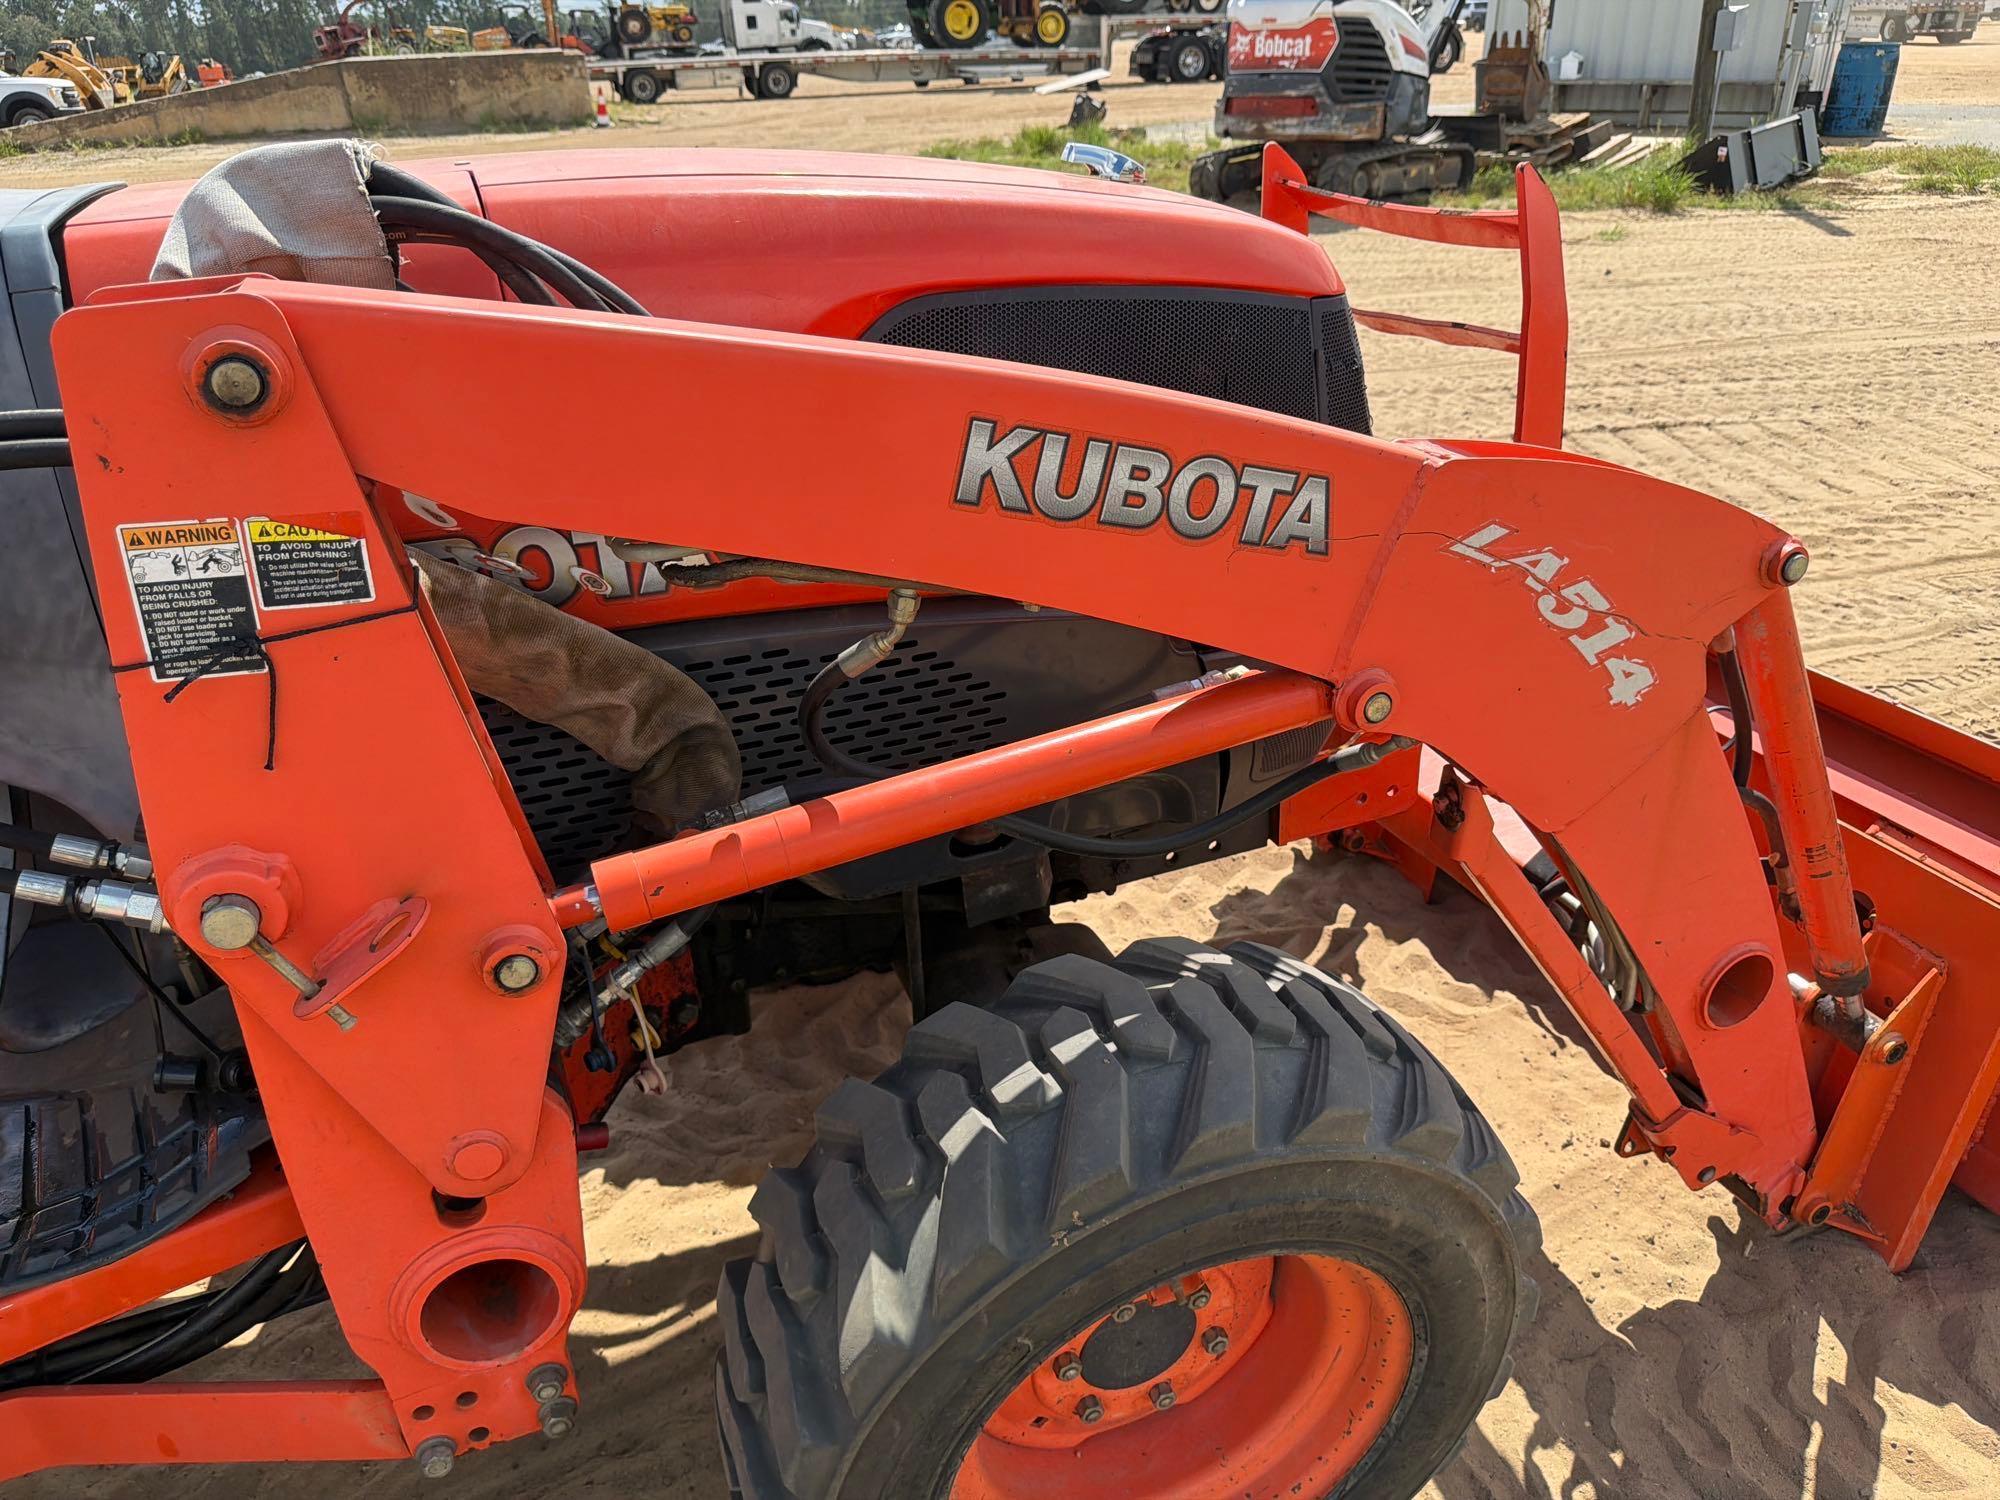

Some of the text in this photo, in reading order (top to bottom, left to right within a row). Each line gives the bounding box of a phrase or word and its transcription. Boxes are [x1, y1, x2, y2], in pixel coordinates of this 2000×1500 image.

[1254, 30, 1312, 57] Bobcat
[955, 416, 1332, 556] KUBOTA
[145, 526, 232, 545] WARNING
[256, 541, 357, 552] TO AVOID INJURY
[258, 551, 351, 561] FROM CRUSHING:
[138, 581, 214, 594] TO AVOID INJURY
[140, 594, 166, 602] FROM
[168, 592, 197, 600] FALLS
[142, 598, 218, 611] BEING CRUSHED:
[208, 614, 233, 622] bucket.
[1449, 523, 1655, 707] LA514
[185, 630, 218, 638] servicing.
[200, 636, 220, 644] loader
[180, 645, 210, 654] platform.
[173, 660, 189, 668] rope
